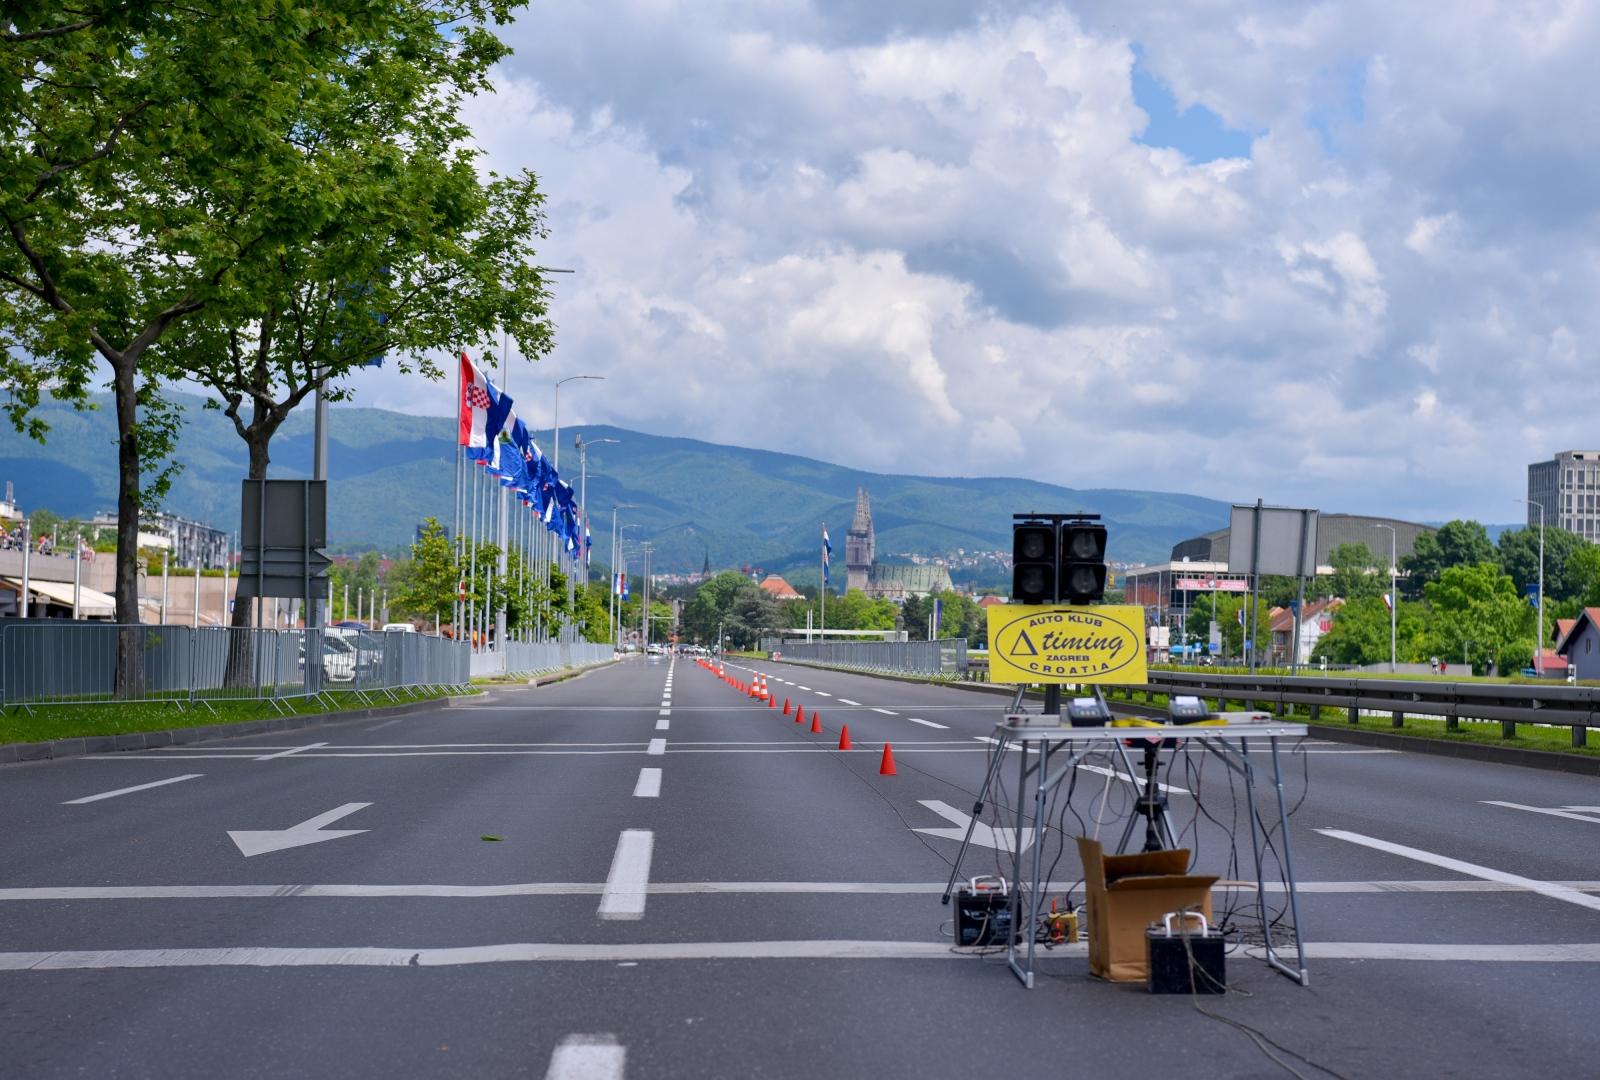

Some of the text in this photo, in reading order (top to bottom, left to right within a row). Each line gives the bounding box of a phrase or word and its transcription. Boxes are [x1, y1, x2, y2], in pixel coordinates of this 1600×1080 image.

[1029, 615, 1103, 627] AUTO KLUB
[1042, 630, 1124, 659] timing
[1029, 662, 1109, 674] CROATIA
